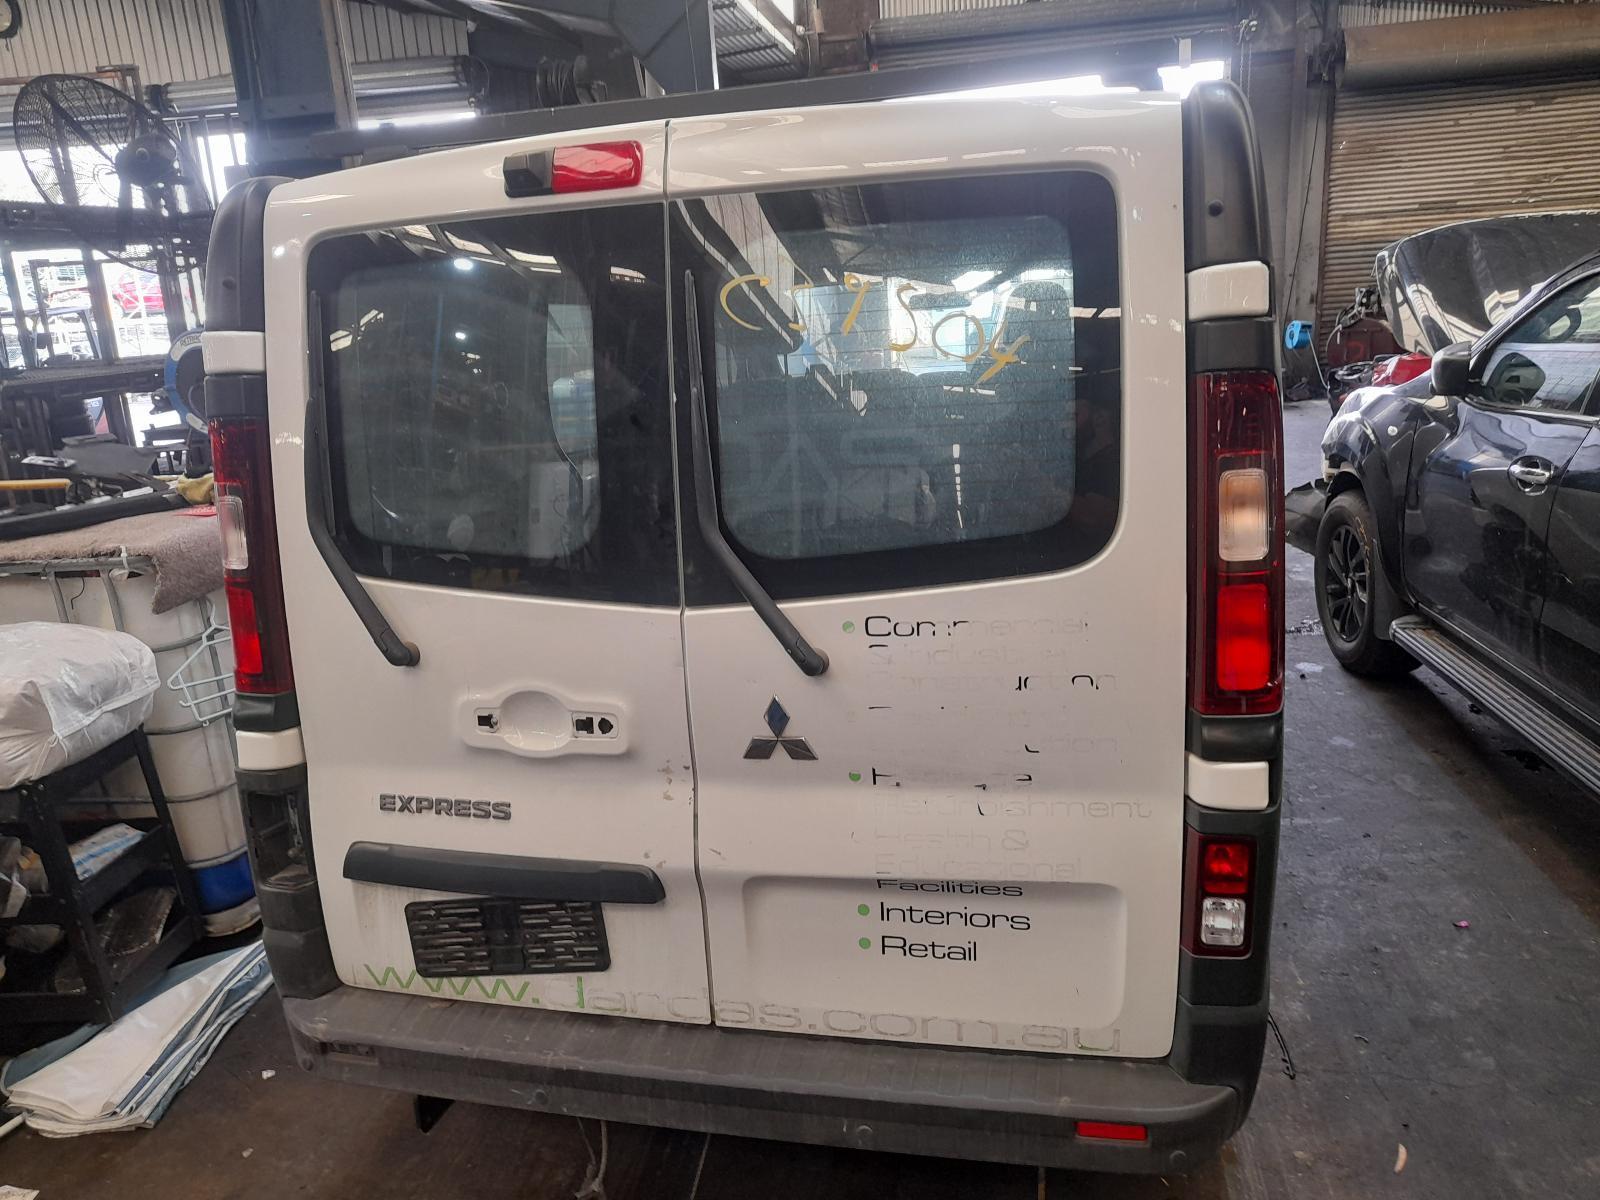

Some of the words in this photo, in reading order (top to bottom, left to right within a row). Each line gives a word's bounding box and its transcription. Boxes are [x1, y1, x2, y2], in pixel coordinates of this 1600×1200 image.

[379, 794, 512, 821] EXPRESS
[877, 878, 1023, 897] Facilities
[880, 902, 1031, 930] Interiors
[881, 935, 977, 961] Retail
